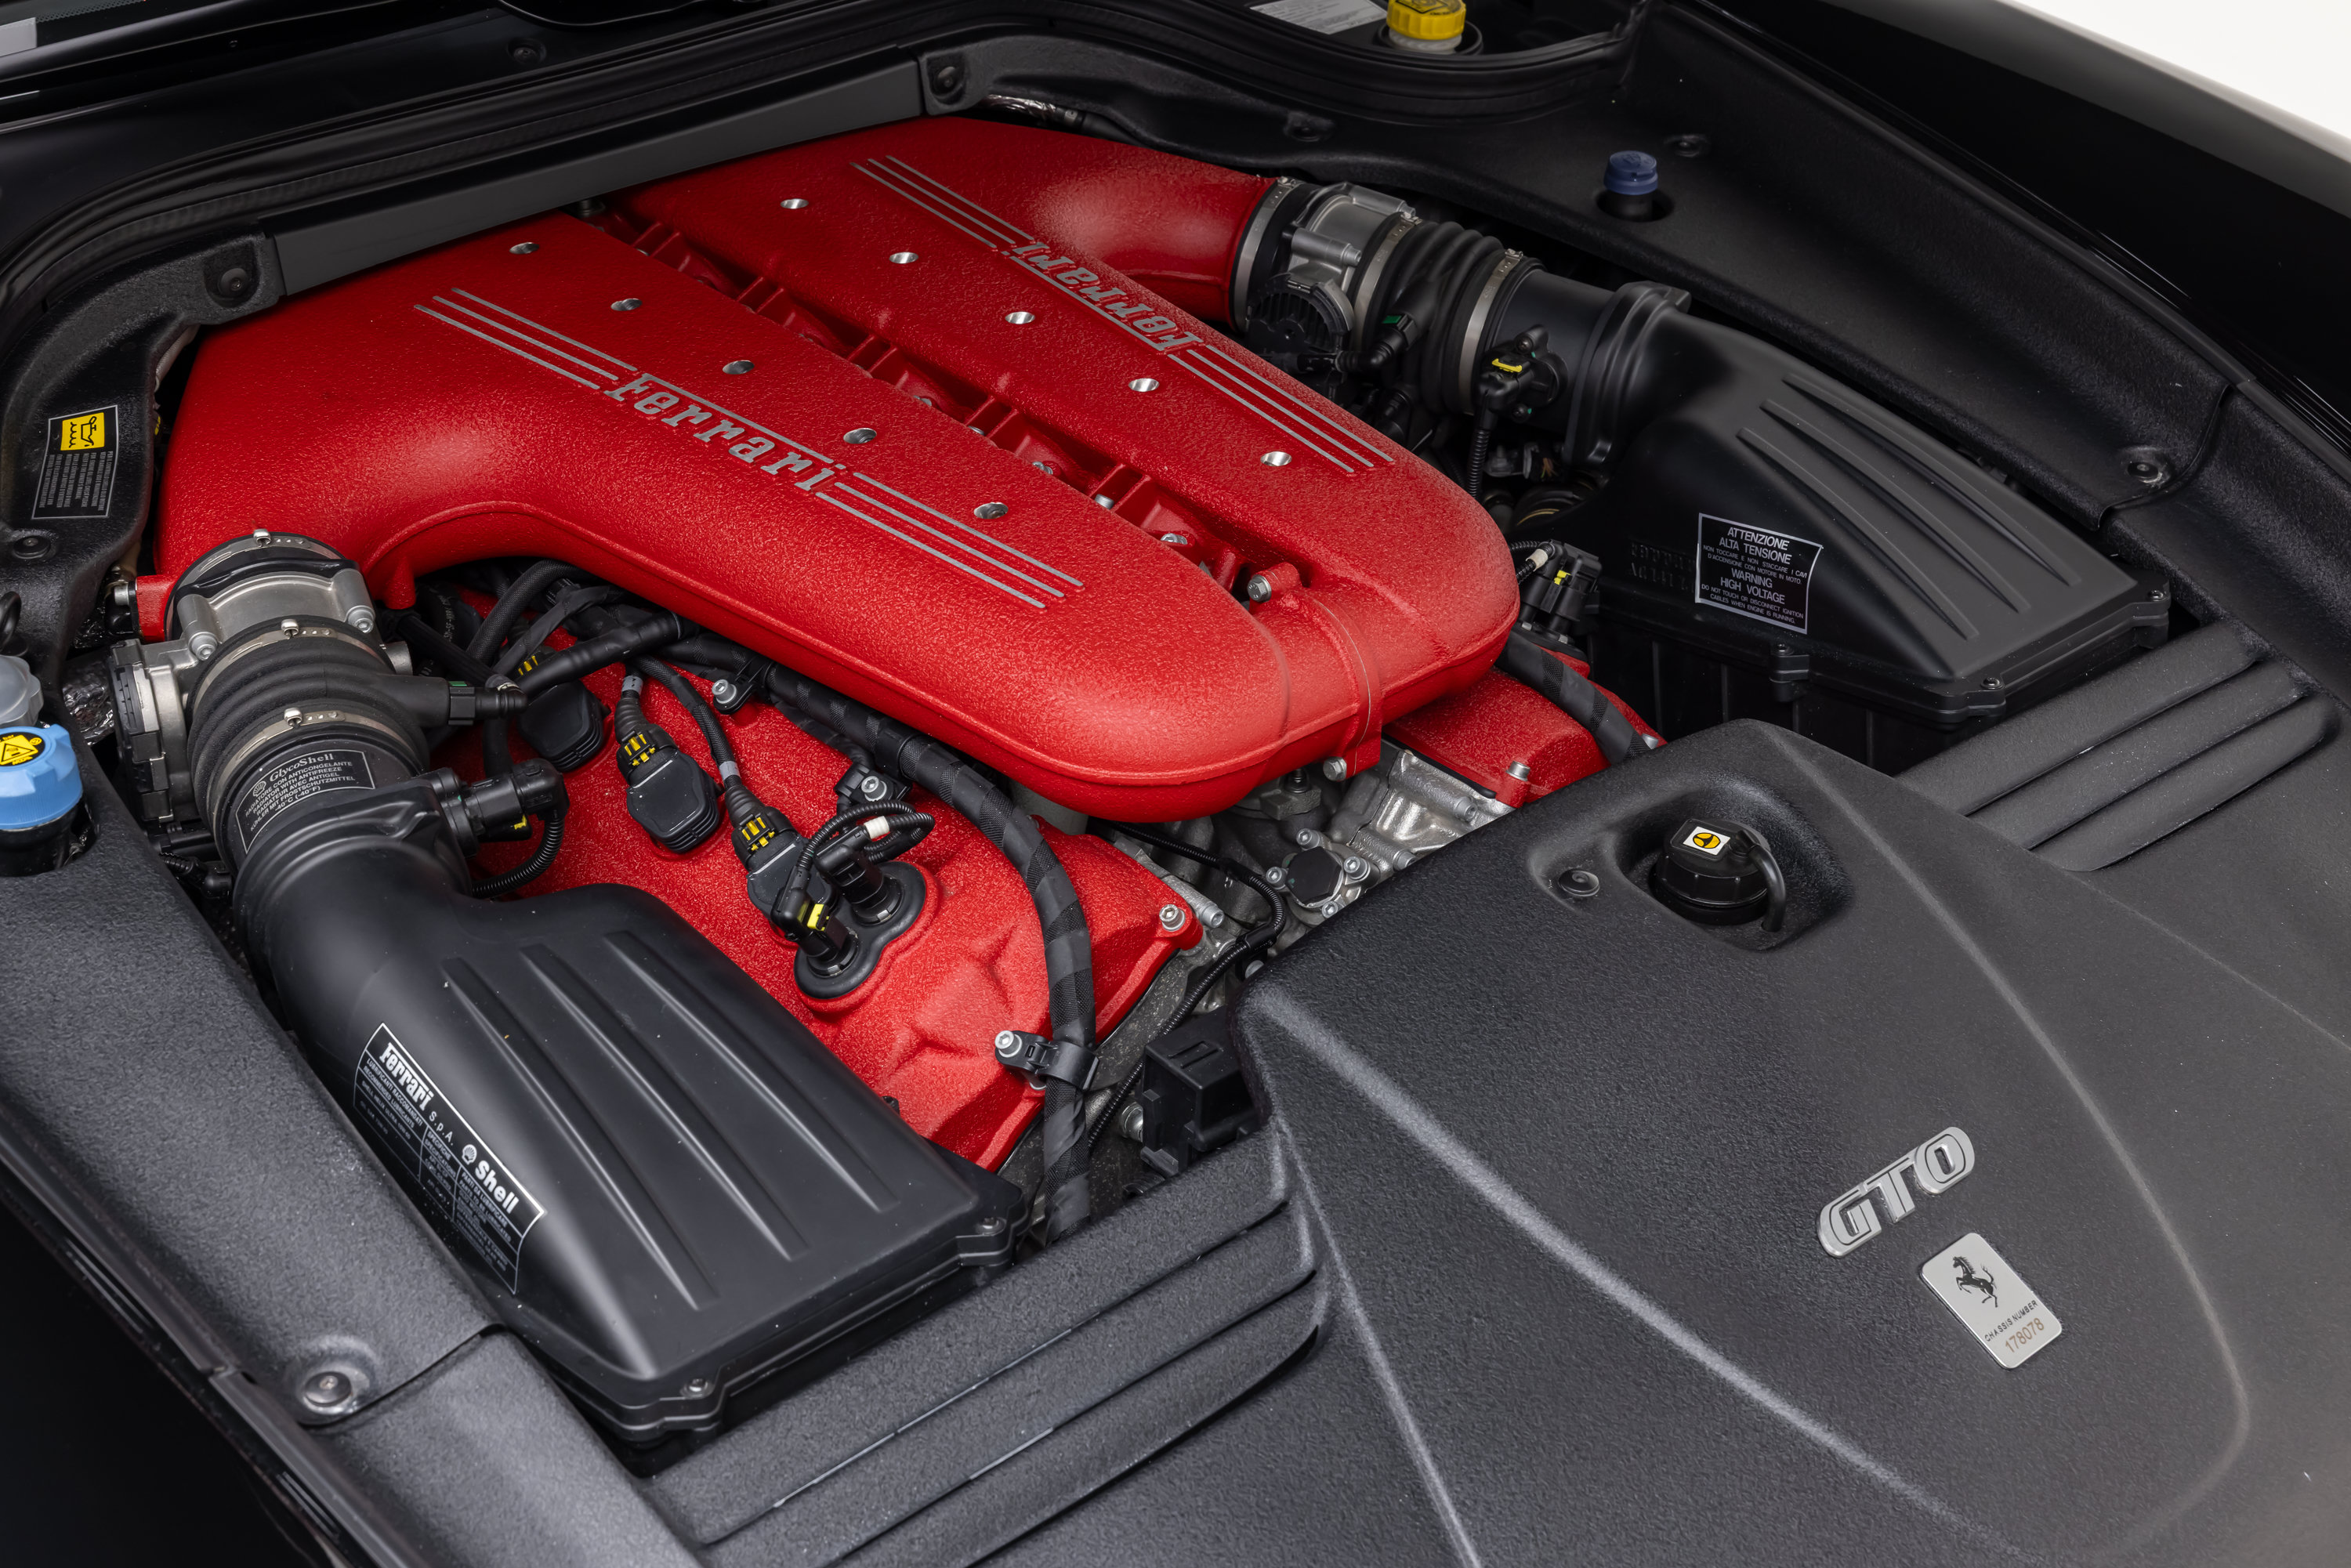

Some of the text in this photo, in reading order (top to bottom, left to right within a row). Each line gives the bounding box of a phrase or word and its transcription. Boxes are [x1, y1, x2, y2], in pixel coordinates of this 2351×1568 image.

[1001, 241, 1204, 352] Ferrari
[603, 372, 846, 492] Ferrari
[1719, 537, 1792, 564] ALTA TENSIONE
[1727, 527, 1790, 551] ATTENZIONE
[1716, 549, 1739, 559] TOCCARE
[1762, 561, 1788, 574] STACCARE
[1731, 568, 1773, 588] WARNING
[1758, 567, 1777, 578] MOTORE
[1710, 594, 1729, 603] CABLES
[1731, 599, 1745, 608] WHEN
[1747, 604, 1765, 614] ENGINE
[1721, 577, 1786, 604] HIGH VOLTAGE
[1722, 590, 1739, 599] TOUCH
[1750, 598, 1780, 612] DISCONNECT
[1783, 608, 1804, 619] IGNITION
[270, 753, 334, 782] GlycoShell
[245, 761, 353, 817] RADIATORE CON ANTICONGELANTE
[253, 767, 342, 813] RADIATOR WITH ANTIFREEZE
[257, 772, 340, 816] RADIATEUR AVEC ANTIGEL
[269, 799, 281, 809] MIT
[281, 777, 355, 801] FROSTSCHUTZMITTEL
[363, 1066, 393, 1101] RECOMMENDED
[390, 1098, 415, 1128] LUBRICANTS
[367, 1058, 394, 1091] LUBRIFICANTI
[392, 1088, 423, 1127] RACCOMANDATI
[378, 1042, 434, 1112] Ferrari
[429, 1110, 453, 1145] S.p.A.
[475, 1161, 520, 1215] Shell
[425, 1138, 457, 1179] SPECIFICATIONS
[459, 1179, 473, 1197] PARTS
[473, 1195, 480, 1205] TO
[462, 1171, 508, 1228] PARTI DA LUBRIFICARE
[1817, 1126, 1975, 1258] GTO
[1985, 1299, 2038, 1342] CHASSIS NUMBER
[2004, 1317, 2045, 1353] 178078
